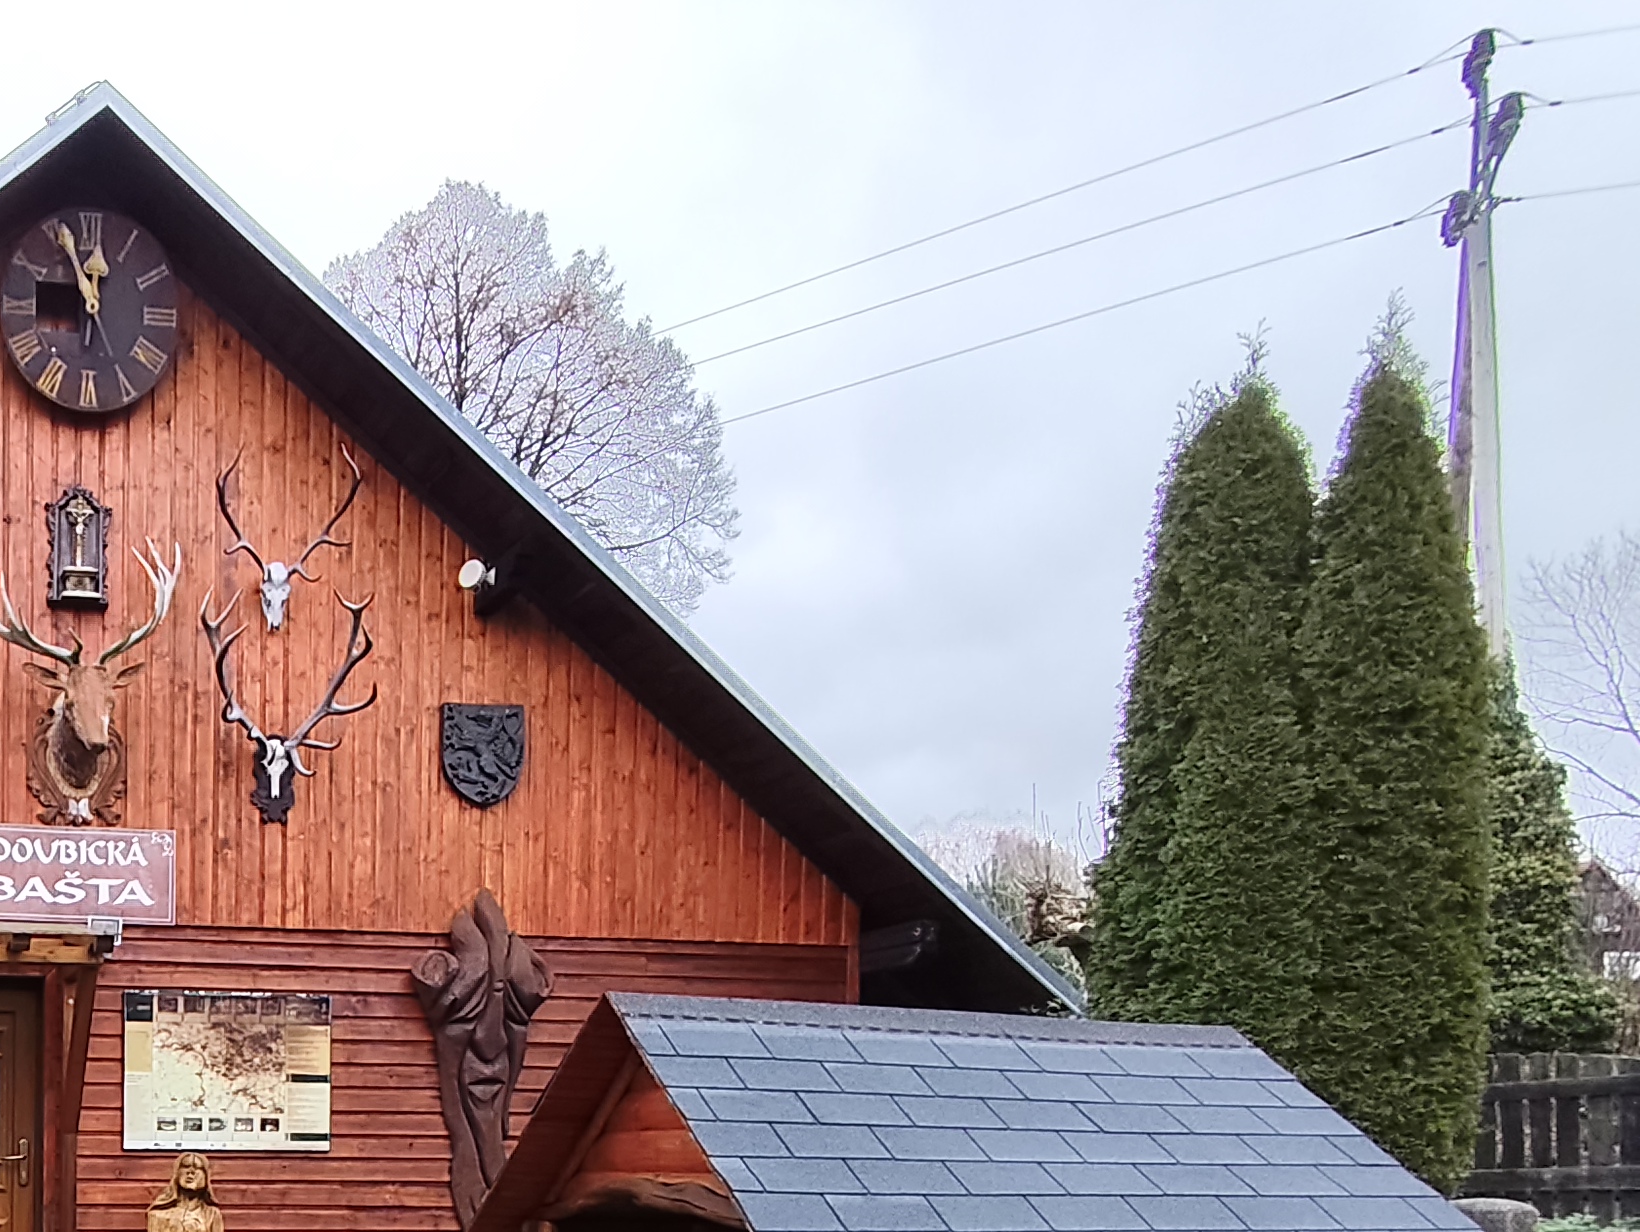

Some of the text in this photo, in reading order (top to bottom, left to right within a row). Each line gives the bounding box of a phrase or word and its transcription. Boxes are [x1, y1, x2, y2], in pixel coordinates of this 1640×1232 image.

[79, 212, 102, 250] XII
[117, 229, 139, 263] I
[12, 250, 48, 281] X
[136, 262, 169, 291] II
[3, 294, 37, 315] IX
[143, 306, 177, 327] III
[9, 329, 42, 367] VIII
[37, 357, 67, 399] VII
[79, 370, 98, 407] VI
[114, 364, 138, 403] V
